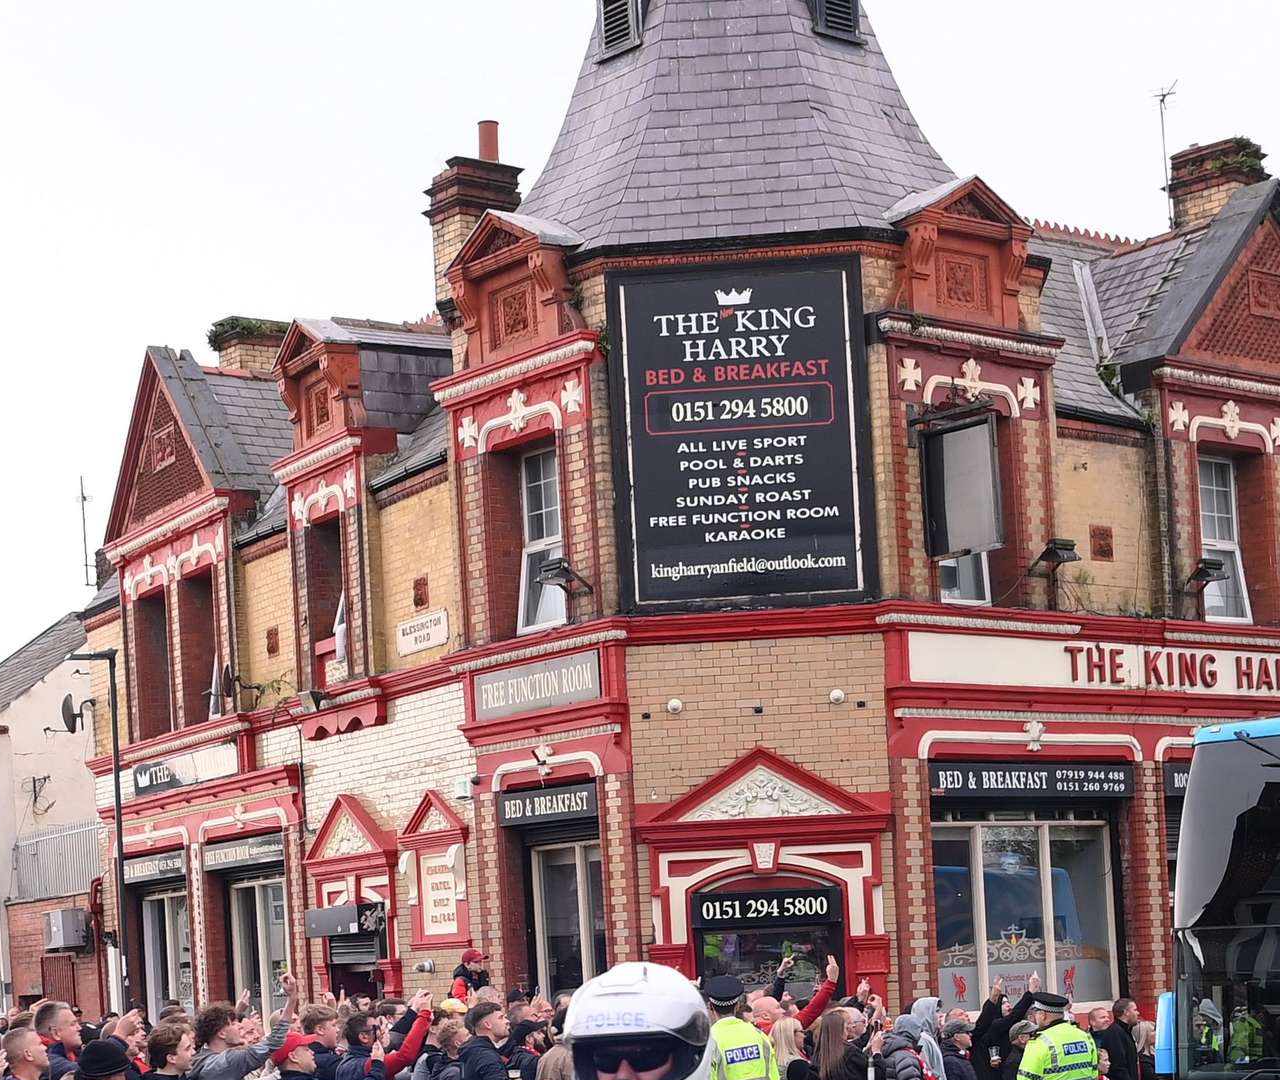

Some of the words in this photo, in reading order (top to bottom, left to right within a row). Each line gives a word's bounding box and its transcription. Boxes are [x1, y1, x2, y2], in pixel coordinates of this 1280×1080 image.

[653, 311, 720, 337] THE
[734, 306, 817, 332] KING
[682, 334, 791, 362] HARRY
[645, 368, 686, 386] BED
[692, 367, 707, 383] &
[714, 359, 830, 382] BREAKFAST
[671, 401, 715, 422] 0151
[719, 399, 756, 420] 294
[760, 396, 809, 416] 5800
[677, 442, 707, 453] ALL
[712, 439, 748, 452] LIVE
[753, 435, 807, 449] SPORT
[679, 459, 727, 471] POOL
[732, 458, 744, 468] &
[749, 454, 804, 467] DARTS
[688, 477, 721, 489] PUB
[727, 472, 796, 487] SNACKS
[676, 493, 749, 508] SUNDAY
[755, 489, 812, 503] ROAST
[649, 515, 687, 527] FREE
[692, 509, 781, 525] FUNCTION
[786, 506, 839, 520] ROOM
[705, 528, 786, 543] KARAOKE
[651, 554, 846, 581] kingharryanfield@outlook.com
[402, 616, 442, 637] BLESSINGTON
[414, 633, 431, 645] ROAD
[1064, 645, 1125, 684] THE
[1143, 650, 1217, 688] KING
[481, 681, 506, 710] FREE
[508, 670, 559, 704] FUNCTION
[562, 663, 592, 694] ROOM
[150, 765, 171, 785] THE
[938, 771, 962, 789] BED
[968, 771, 977, 789] &
[982, 771, 1048, 789] BREAKFAST
[1055, 770, 1084, 780] 07919
[1088, 771, 1105, 780] 944
[1108, 771, 1125, 781] 488
[1056, 782, 1079, 791] 0151
[1083, 782, 1100, 791] 260
[1103, 782, 1125, 792] 9769
[504, 799, 523, 819] BED
[525, 798, 532, 817] &
[534, 791, 588, 815] BREAKFAST
[702, 901, 742, 919] 0151
[746, 898, 780, 918] 294
[783, 896, 827, 916] 5800
[585, 1012, 646, 1030] POLICE
[726, 1045, 760, 1063] POLICE
[1064, 1042, 1088, 1055] POLICE
